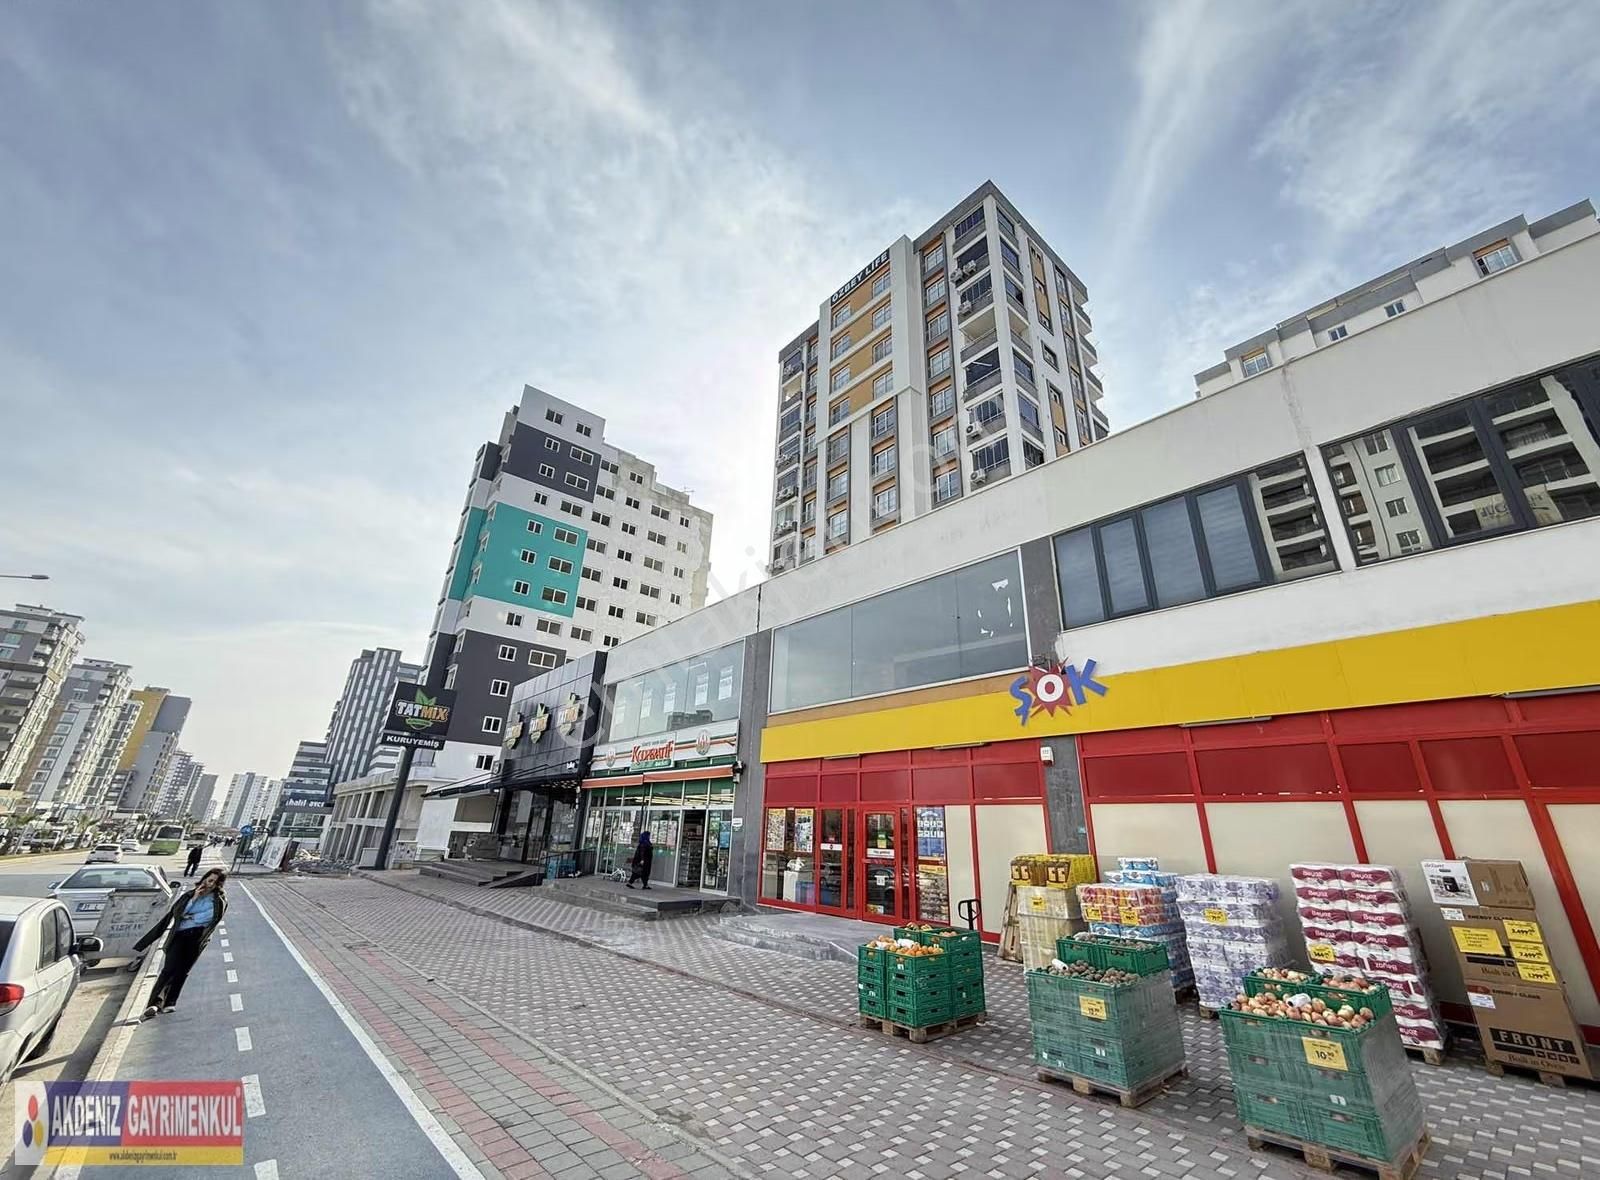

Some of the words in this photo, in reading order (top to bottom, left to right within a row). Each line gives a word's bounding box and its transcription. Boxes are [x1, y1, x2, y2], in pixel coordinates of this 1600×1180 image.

[1010, 658, 1108, 726] ŞOK
[386, 735, 440, 748] KURUYEMİŞ
[1500, 1030, 1565, 1052] FRONT
[1315, 1049, 1327, 1060] 10
